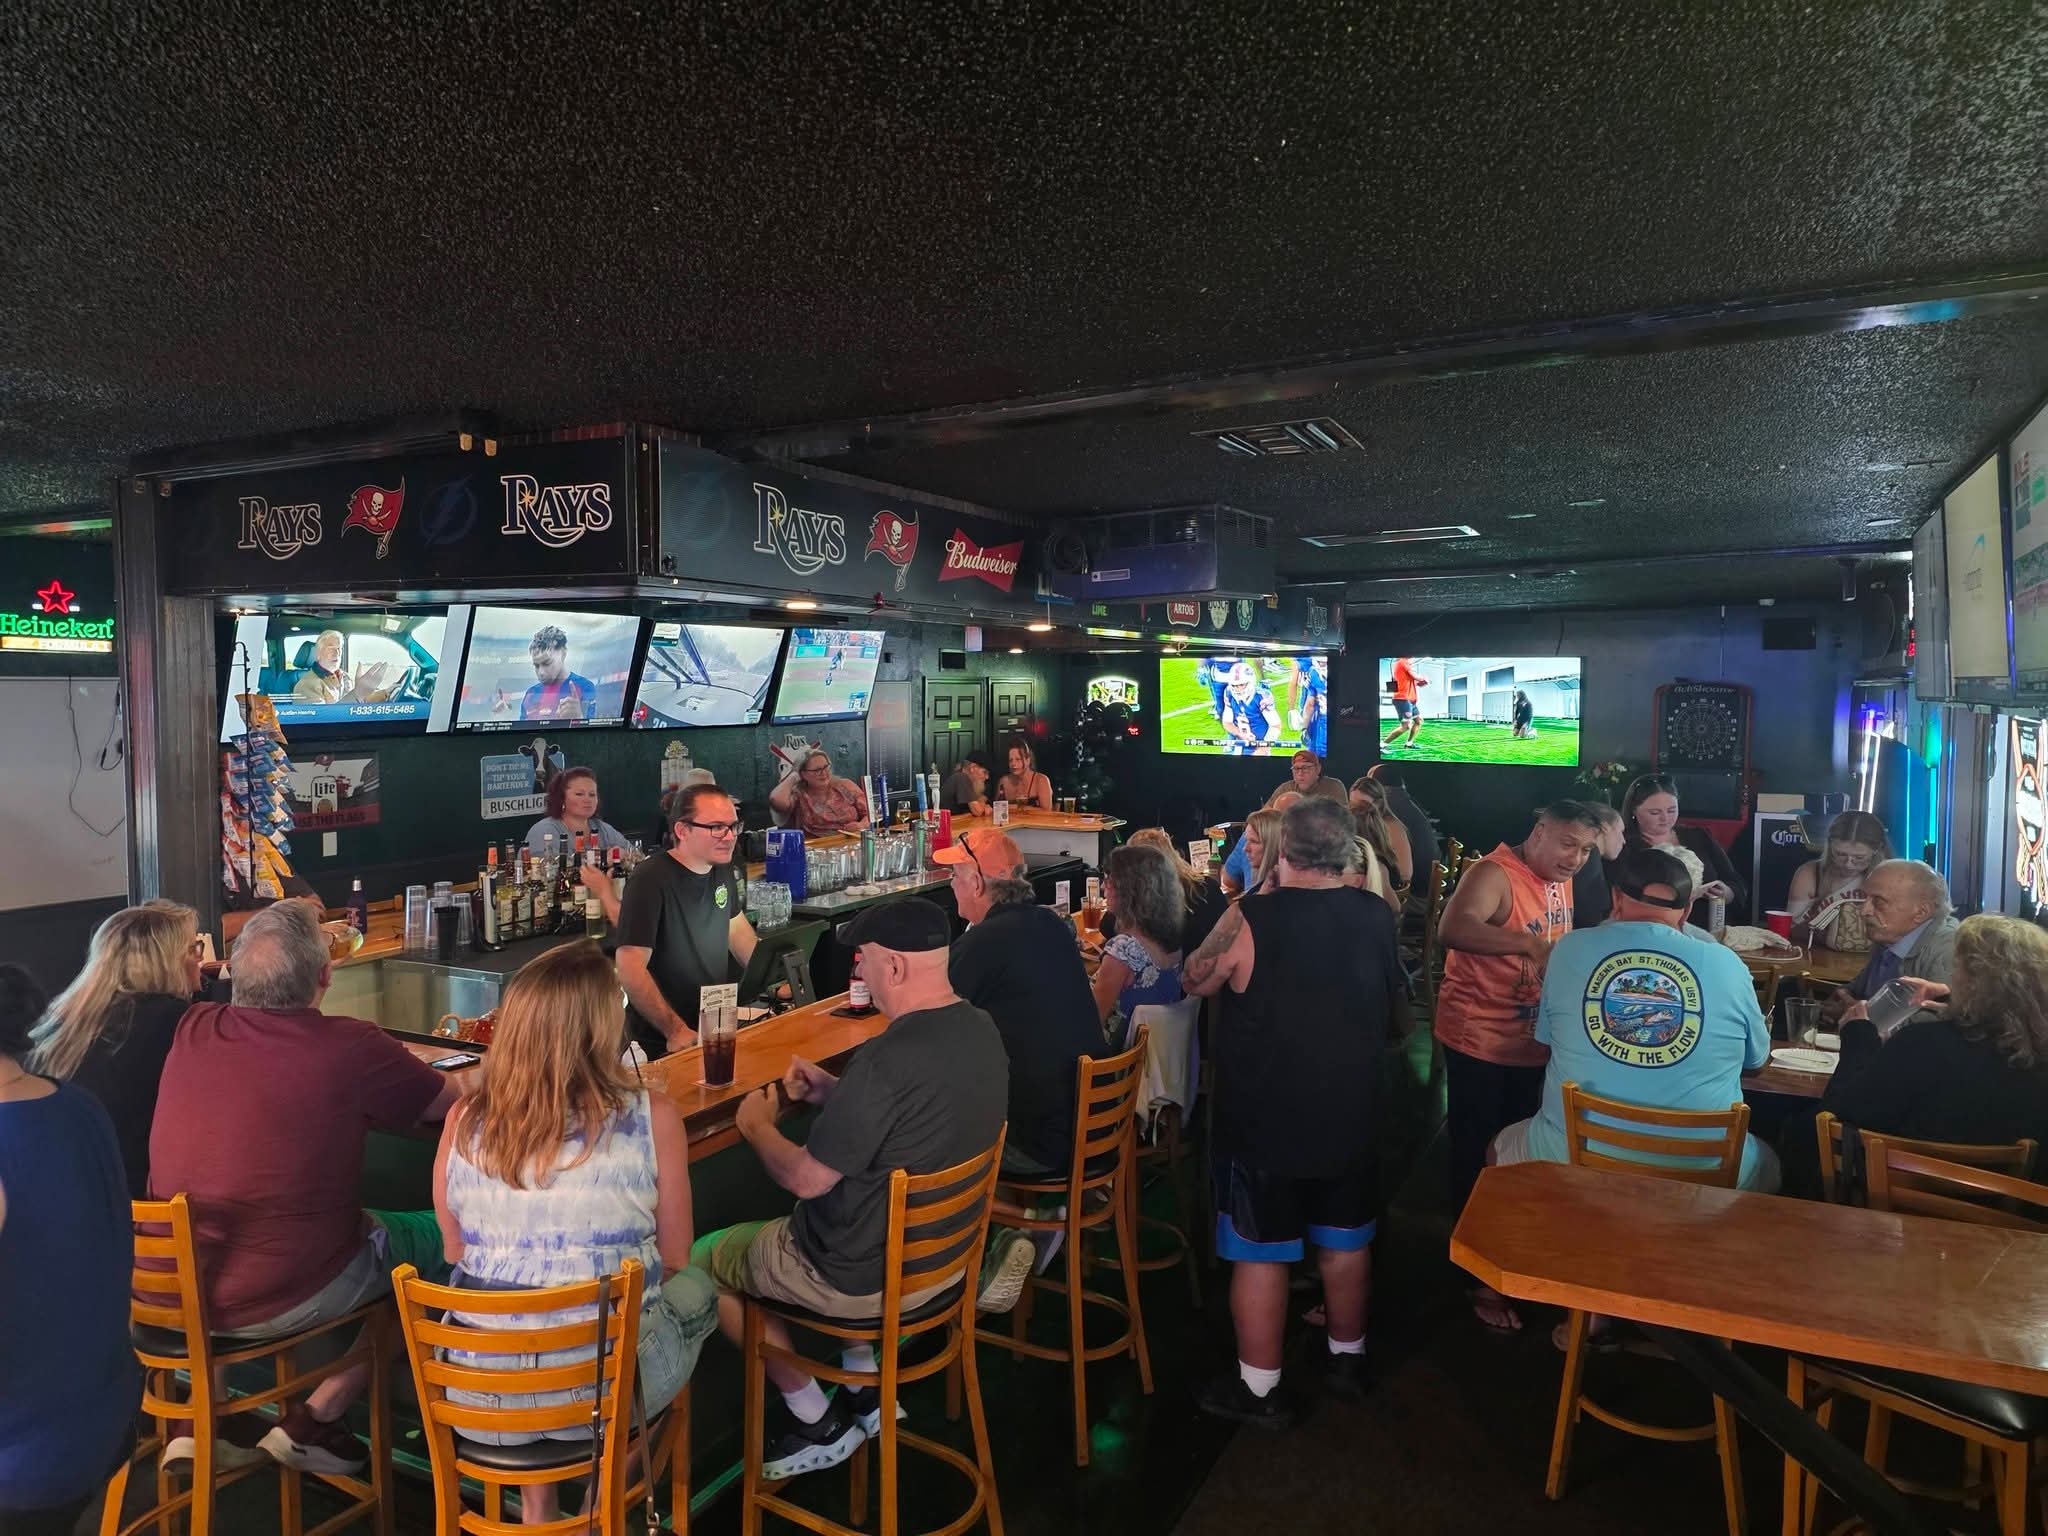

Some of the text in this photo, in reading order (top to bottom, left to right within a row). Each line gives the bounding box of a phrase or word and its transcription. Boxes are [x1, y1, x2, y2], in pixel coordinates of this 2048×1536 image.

[237, 496, 323, 560] RAYS
[500, 474, 612, 548] RAYS
[753, 482, 847, 576] RAYS
[945, 539, 1018, 575] Budweiser
[0, 613, 115, 639] Heineken
[314, 782, 336, 798] Lite
[487, 781, 529, 791] BARTENDER
[490, 797, 546, 814] BUSCH LIG
[1615, 955, 1634, 968] BAY
[1639, 956, 1653, 965] ST.
[1655, 958, 1690, 983] THOMAS
[1685, 986, 1698, 1008] USVI
[1588, 1015, 1697, 1065] GO WITH THE FLOW
